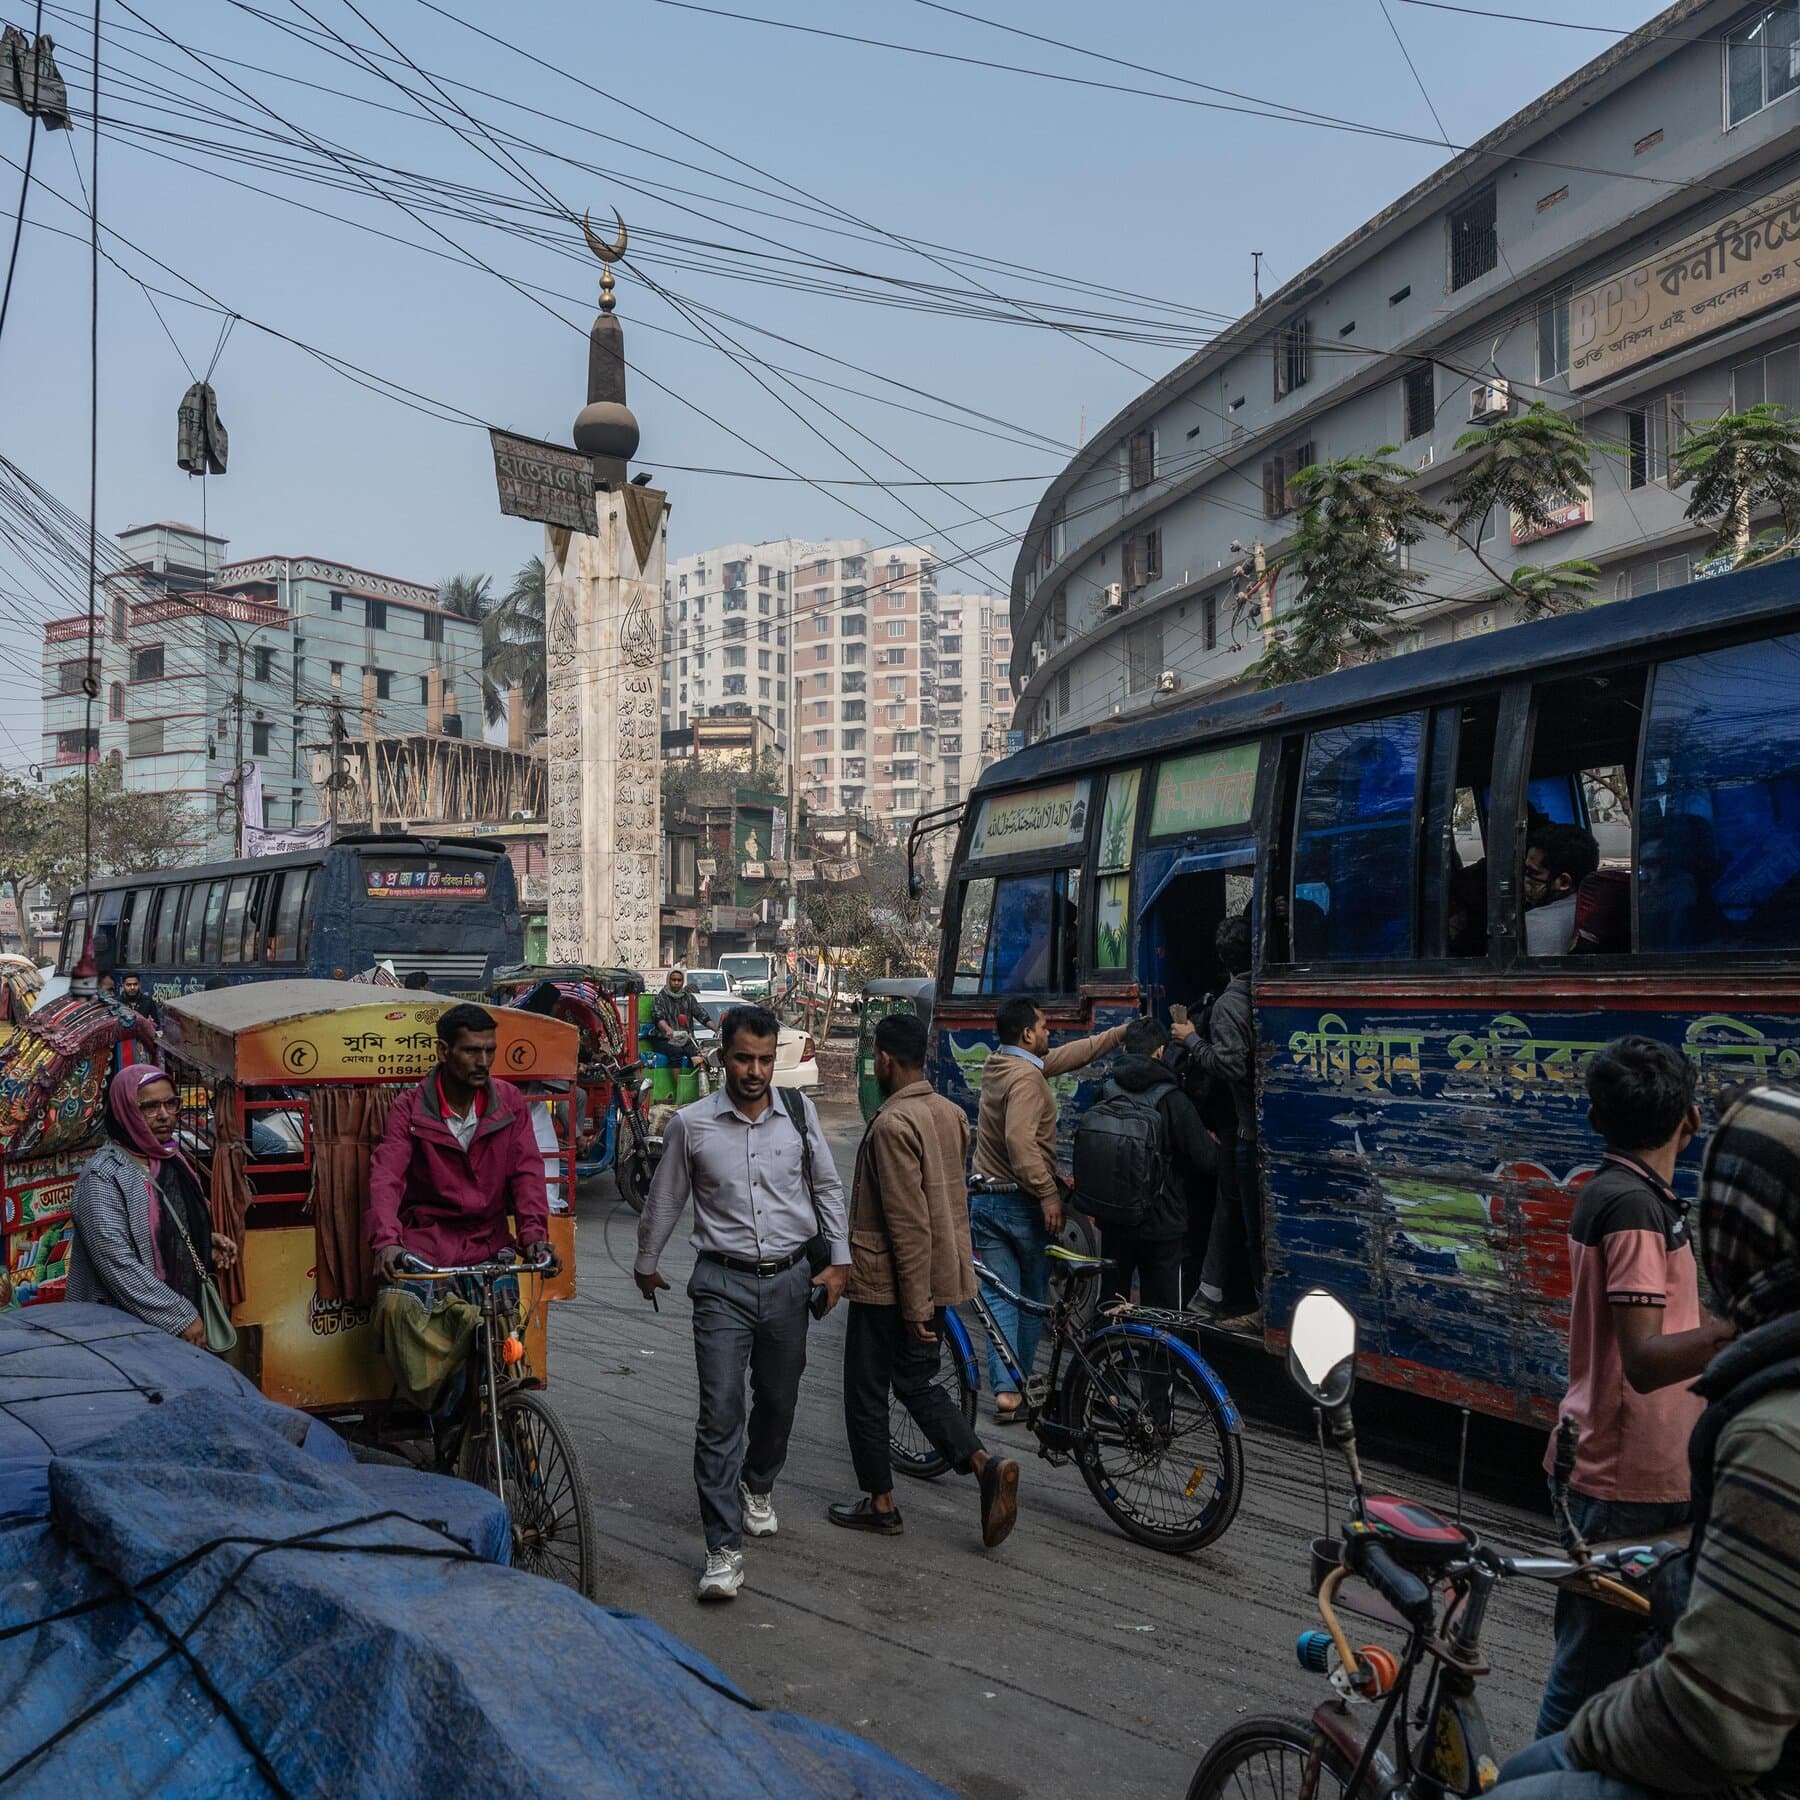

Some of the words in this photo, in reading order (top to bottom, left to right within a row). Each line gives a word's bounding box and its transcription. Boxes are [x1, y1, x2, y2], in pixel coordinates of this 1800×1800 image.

[1573, 268, 1649, 350] BCS
[1573, 344, 1603, 369] ভর্তি
[1609, 326, 1654, 353] অফিস
[1659, 309, 1687, 331] এই
[1692, 282, 1751, 314] ভবনের
[500, 455, 553, 486] হাতের
[556, 468, 593, 497] লেখা
[342, 1032, 386, 1052] সুমি
[395, 1032, 439, 1049] পরি
[378, 1054, 439, 1063] 01721-0
[40, 1185, 74, 1207] আয়ে
